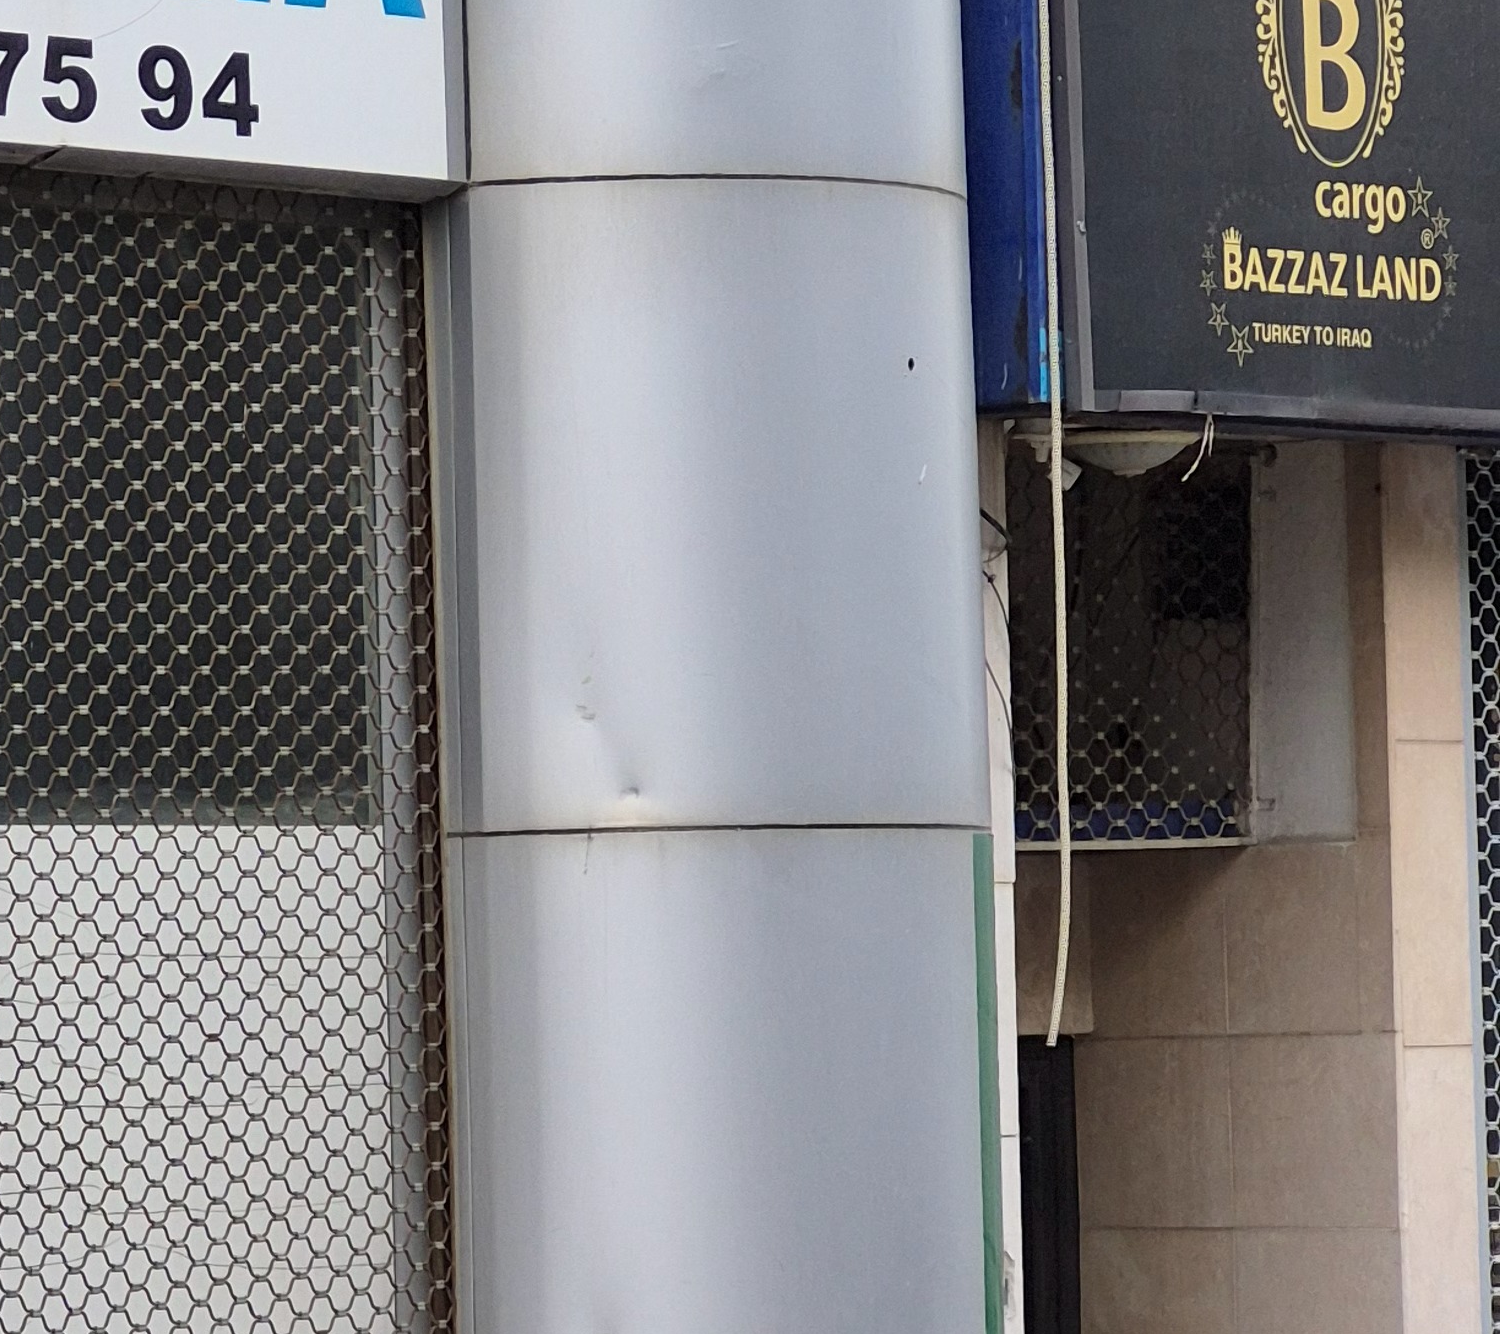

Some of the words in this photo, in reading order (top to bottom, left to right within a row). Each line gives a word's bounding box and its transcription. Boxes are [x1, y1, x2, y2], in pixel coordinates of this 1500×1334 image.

[136, 44, 260, 138] 94
[1314, 179, 1407, 235] cargo
[1221, 241, 1349, 299] BAZZAZ
[1355, 253, 1443, 303] LAND
[1251, 321, 1312, 346] TURKEY
[1313, 325, 1335, 346] TO
[1336, 326, 1373, 349] IRAQ
